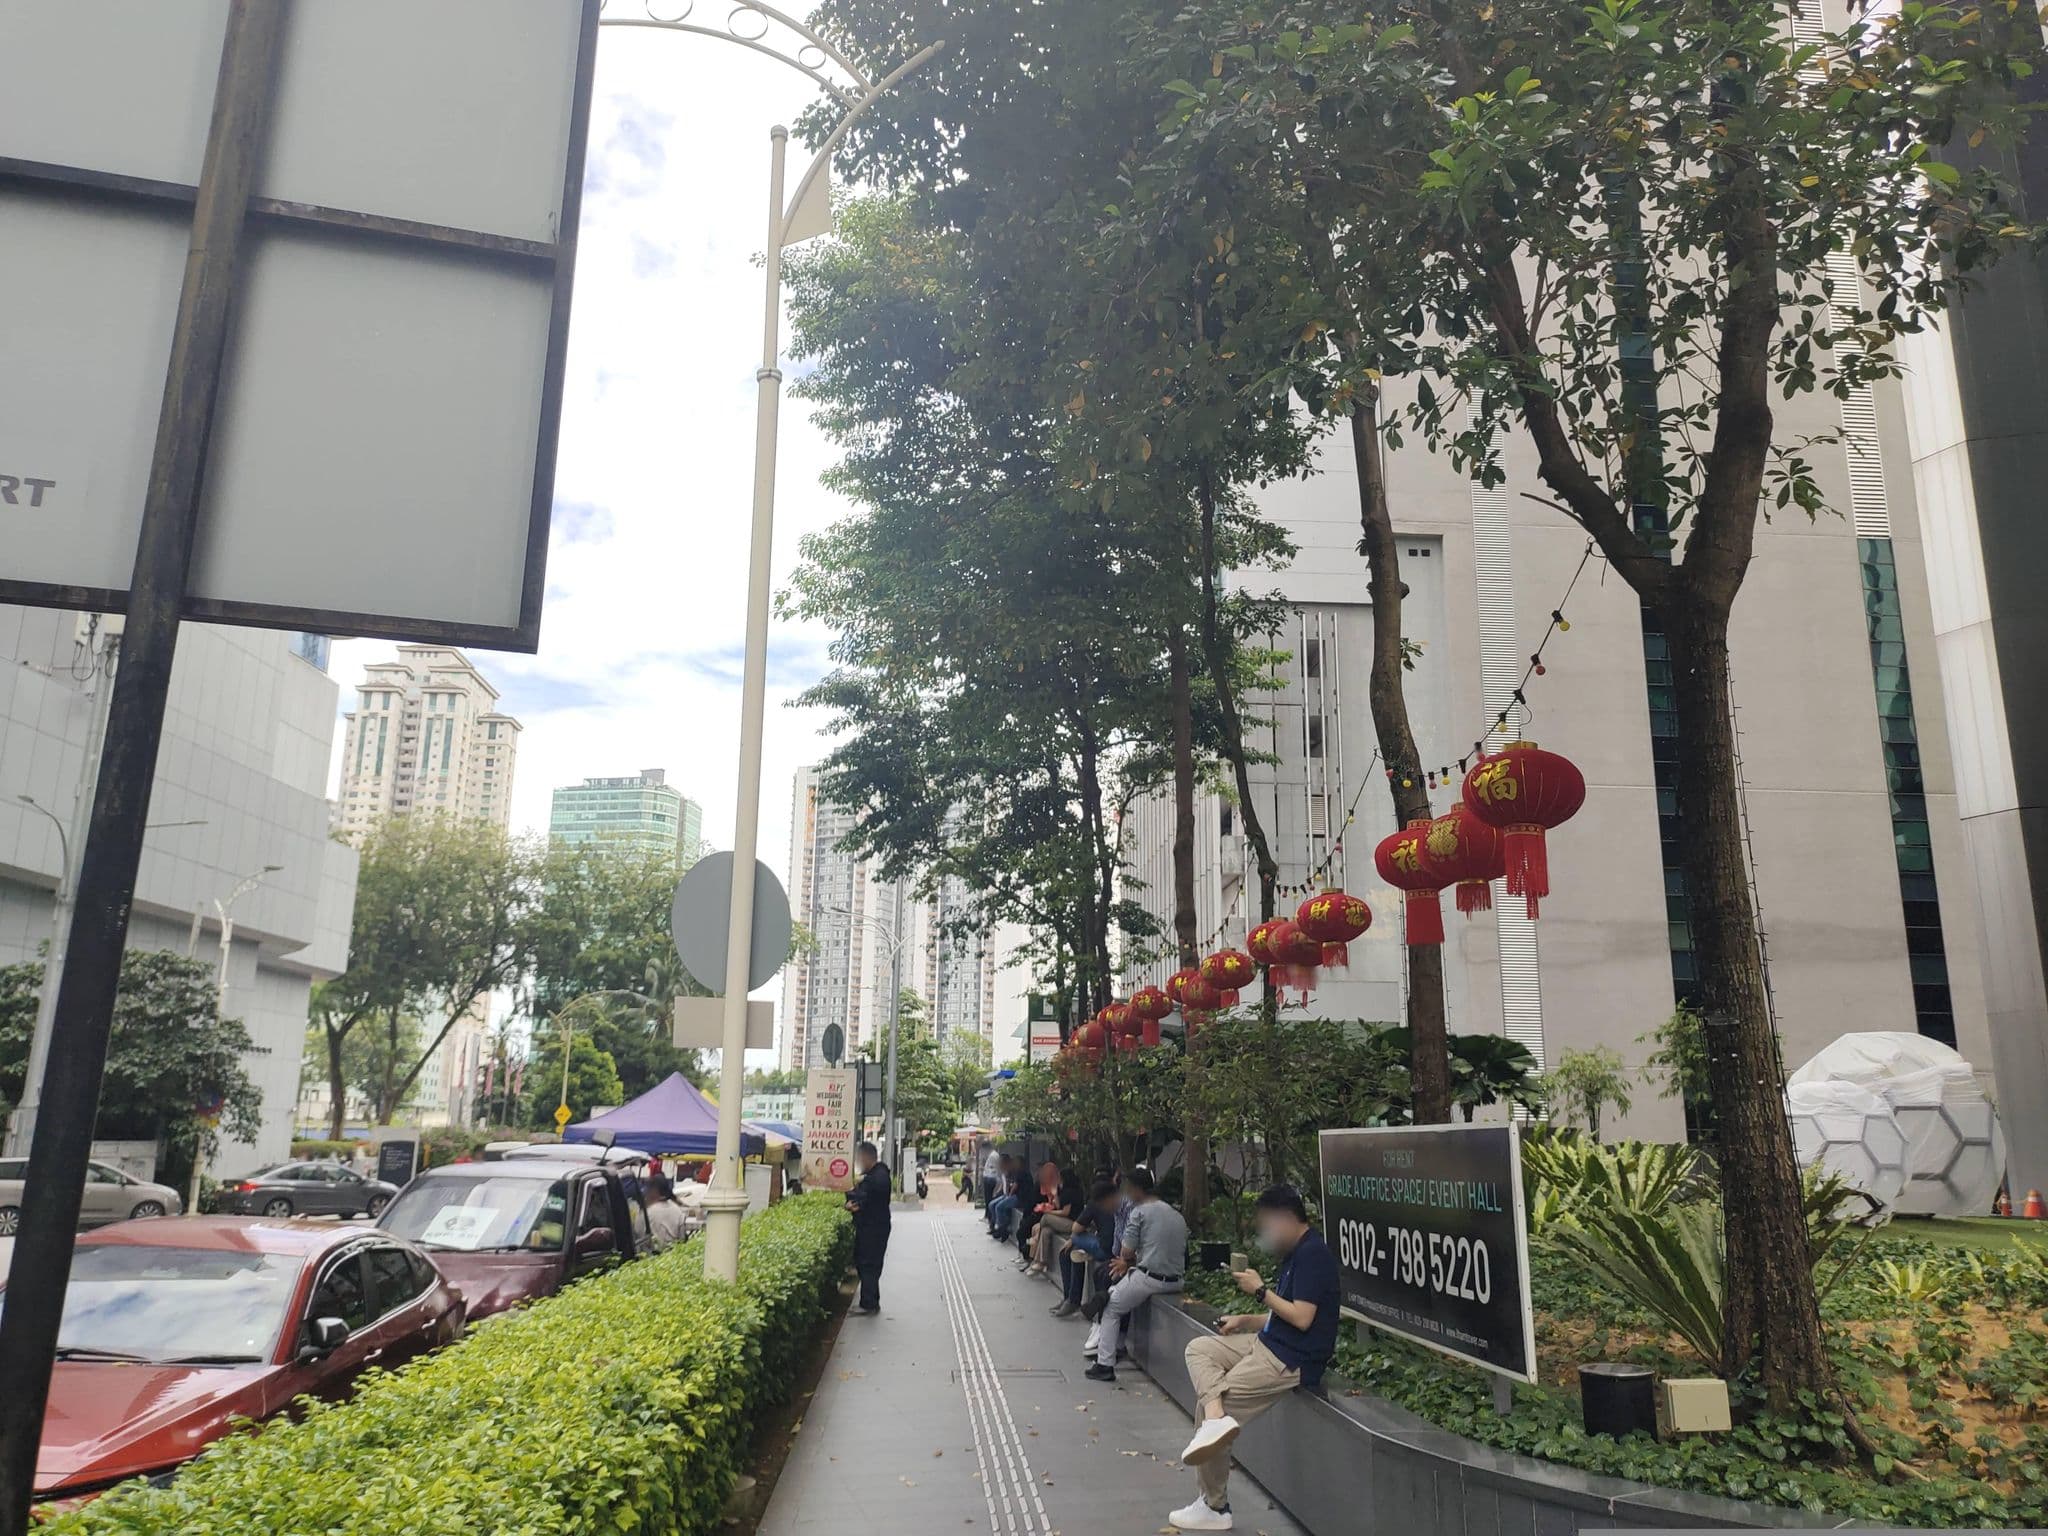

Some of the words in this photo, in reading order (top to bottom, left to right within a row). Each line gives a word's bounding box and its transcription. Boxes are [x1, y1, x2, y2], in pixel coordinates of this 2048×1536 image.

[1472, 758, 1518, 806] 福
[817, 1092, 843, 1100] WEDDING
[827, 1100, 842, 1108] FAIR
[811, 1119, 822, 1129] 11
[825, 1120, 833, 1128] &
[835, 1120, 849, 1130] 12
[807, 1131, 851, 1139] JANUARY
[811, 1140, 845, 1150] KLCC
[1383, 1150, 1397, 1168] FOR
[1397, 1150, 1415, 1169] RENT
[1327, 1174, 1352, 1198] GRADE
[1354, 1176, 1361, 1199] A
[1360, 1176, 1391, 1203] OFFICE
[1429, 1179, 1465, 1209] EVENT
[1467, 1182, 1503, 1213] HALL
[1339, 1217, 1386, 1276] 6012-
[1388, 1226, 1426, 1288] 798
[1429, 1233, 1491, 1305] 5220
